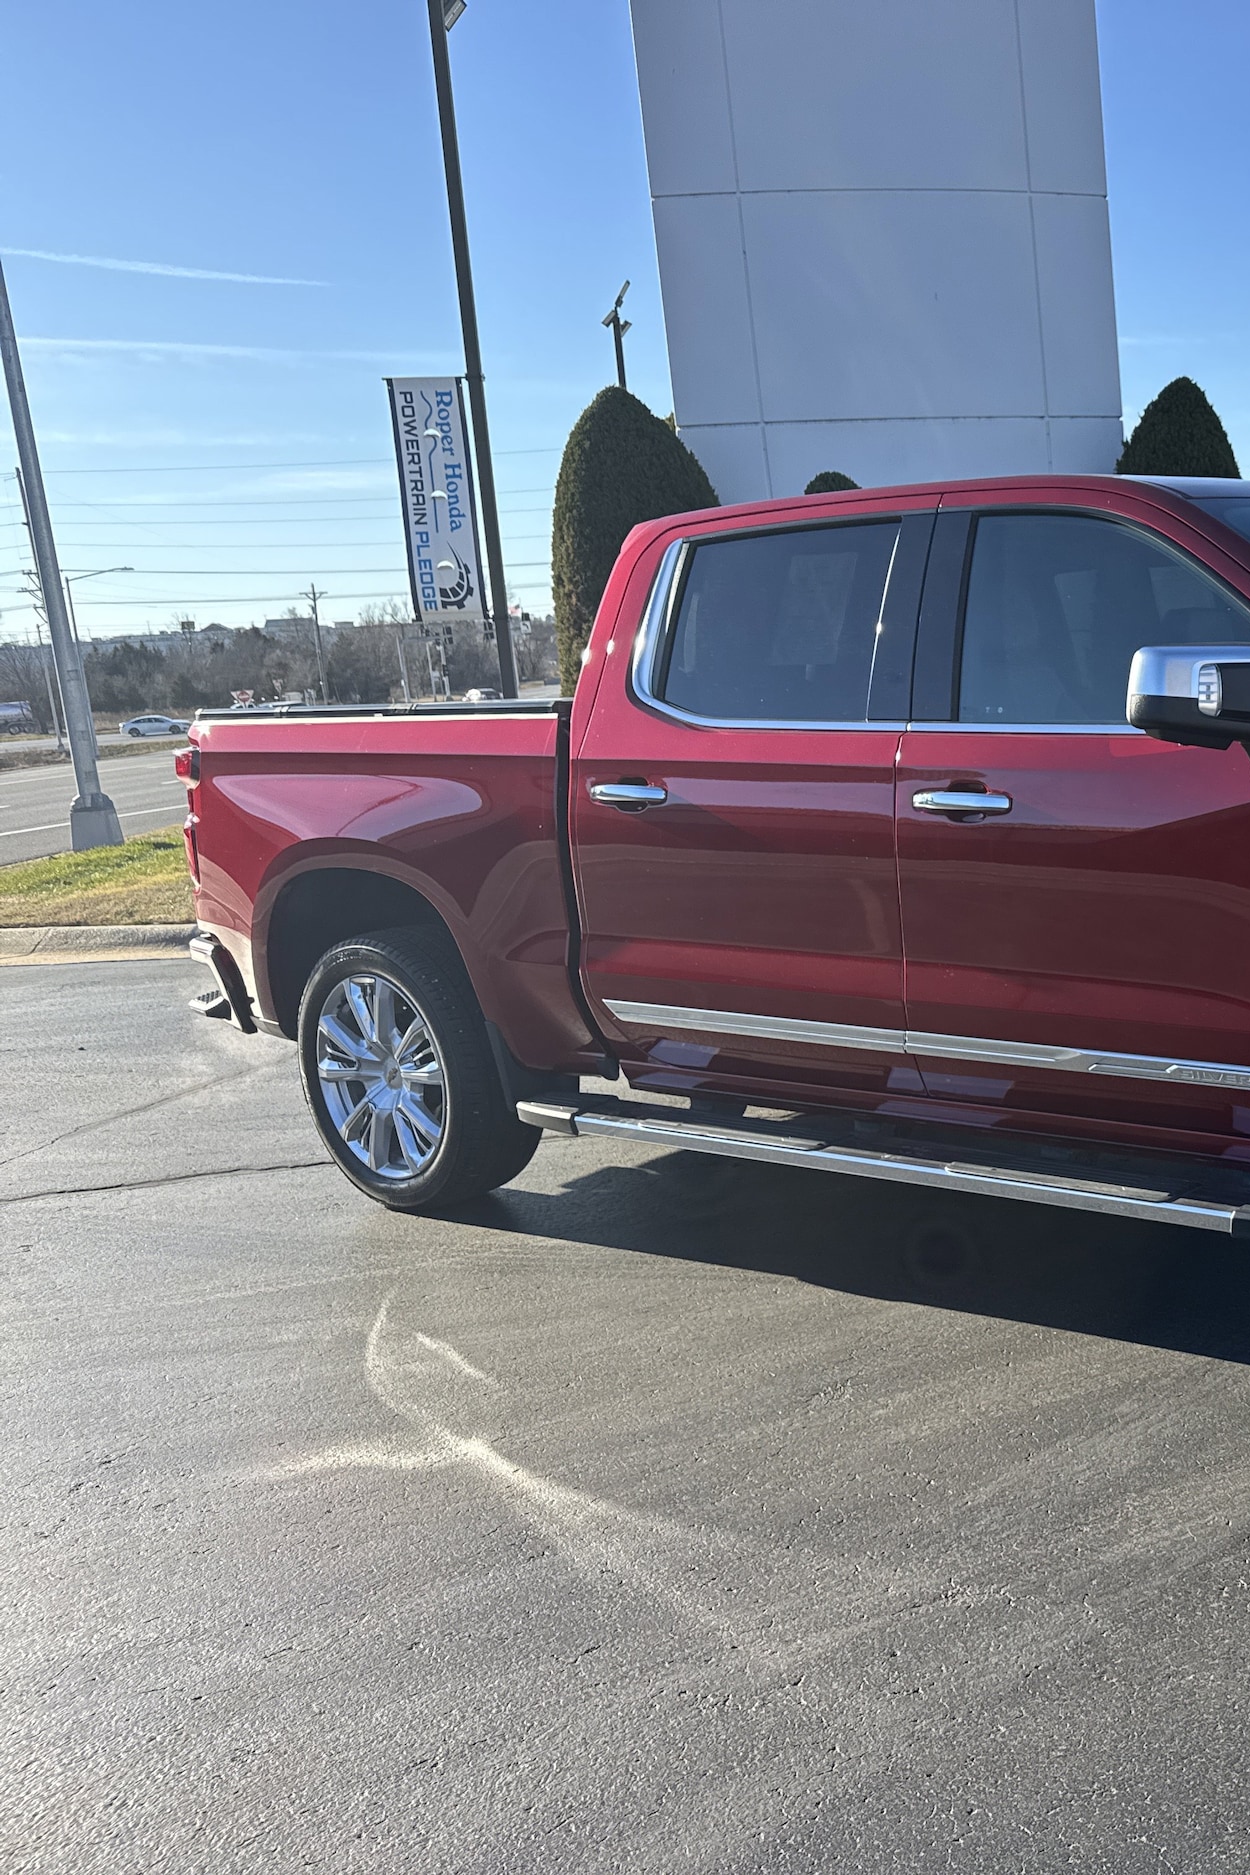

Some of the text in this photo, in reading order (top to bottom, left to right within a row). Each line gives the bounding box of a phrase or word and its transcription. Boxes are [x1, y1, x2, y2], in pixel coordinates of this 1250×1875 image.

[399, 391, 438, 612] POWERTRAIN PLEDGE
[435, 390, 466, 532] Roper Honda
